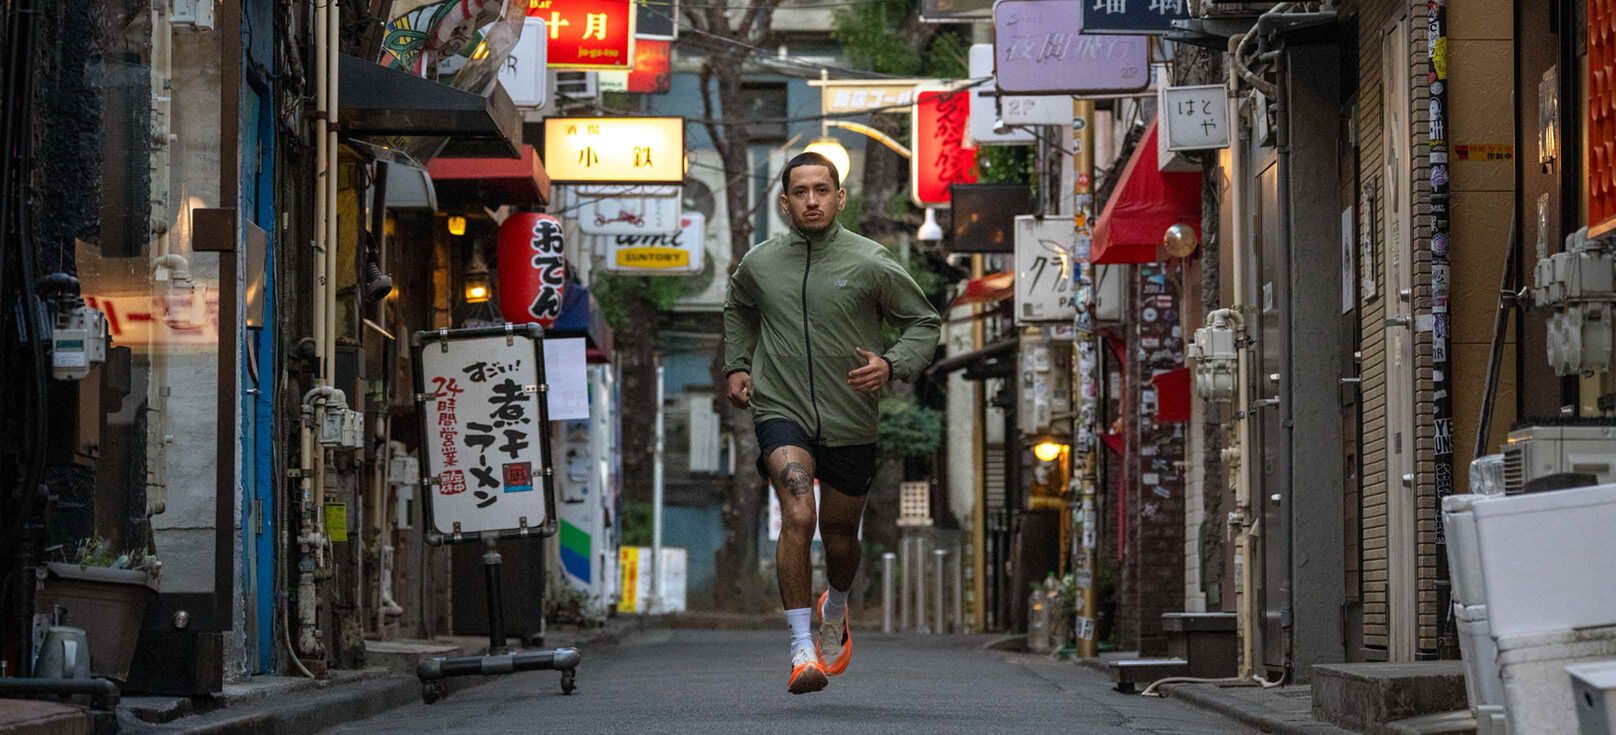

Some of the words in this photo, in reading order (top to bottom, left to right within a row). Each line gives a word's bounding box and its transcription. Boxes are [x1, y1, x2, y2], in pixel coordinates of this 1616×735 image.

[545, 11, 607, 41] 十月
[578, 146, 654, 168] 小鉄
[530, 220, 564, 318] おでん
[625, 253, 681, 262] SUNTORY
[487, 378, 532, 460] 煮干
[463, 421, 501, 509] ラーメン
